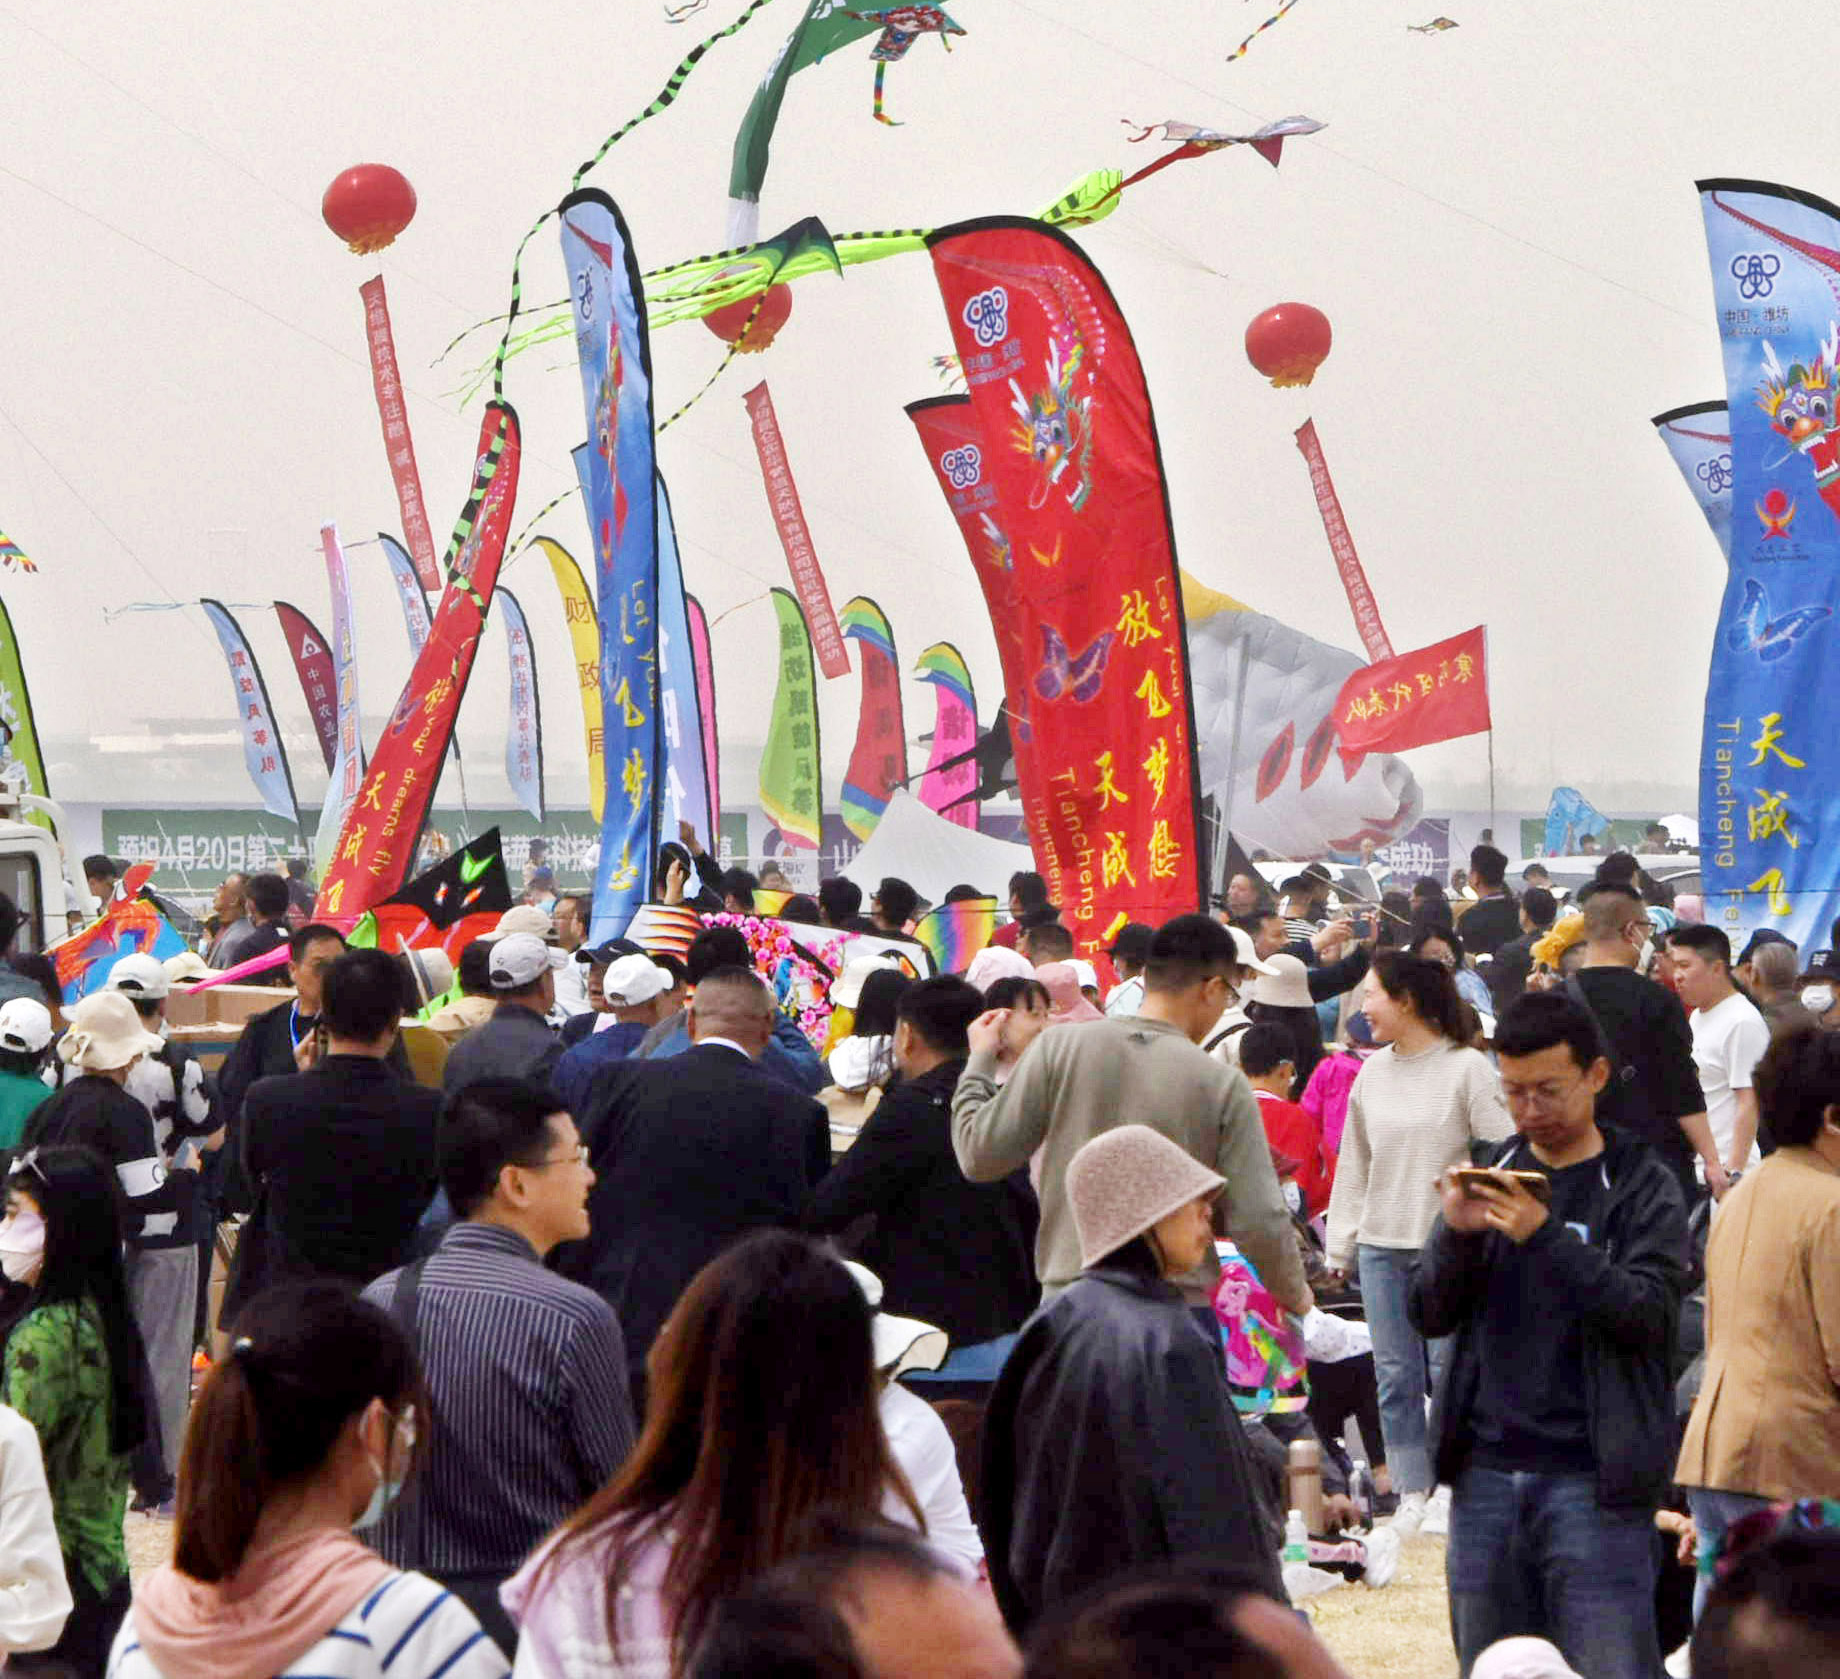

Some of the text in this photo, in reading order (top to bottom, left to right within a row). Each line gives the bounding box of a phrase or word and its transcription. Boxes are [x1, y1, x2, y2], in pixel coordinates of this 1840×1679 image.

[565, 596, 605, 757] 财政局
[368, 849, 392, 877] fly
[381, 768, 416, 837] dreams
[1049, 767, 1097, 920] Tiancheng
[1714, 717, 1743, 869] Tiancheng
